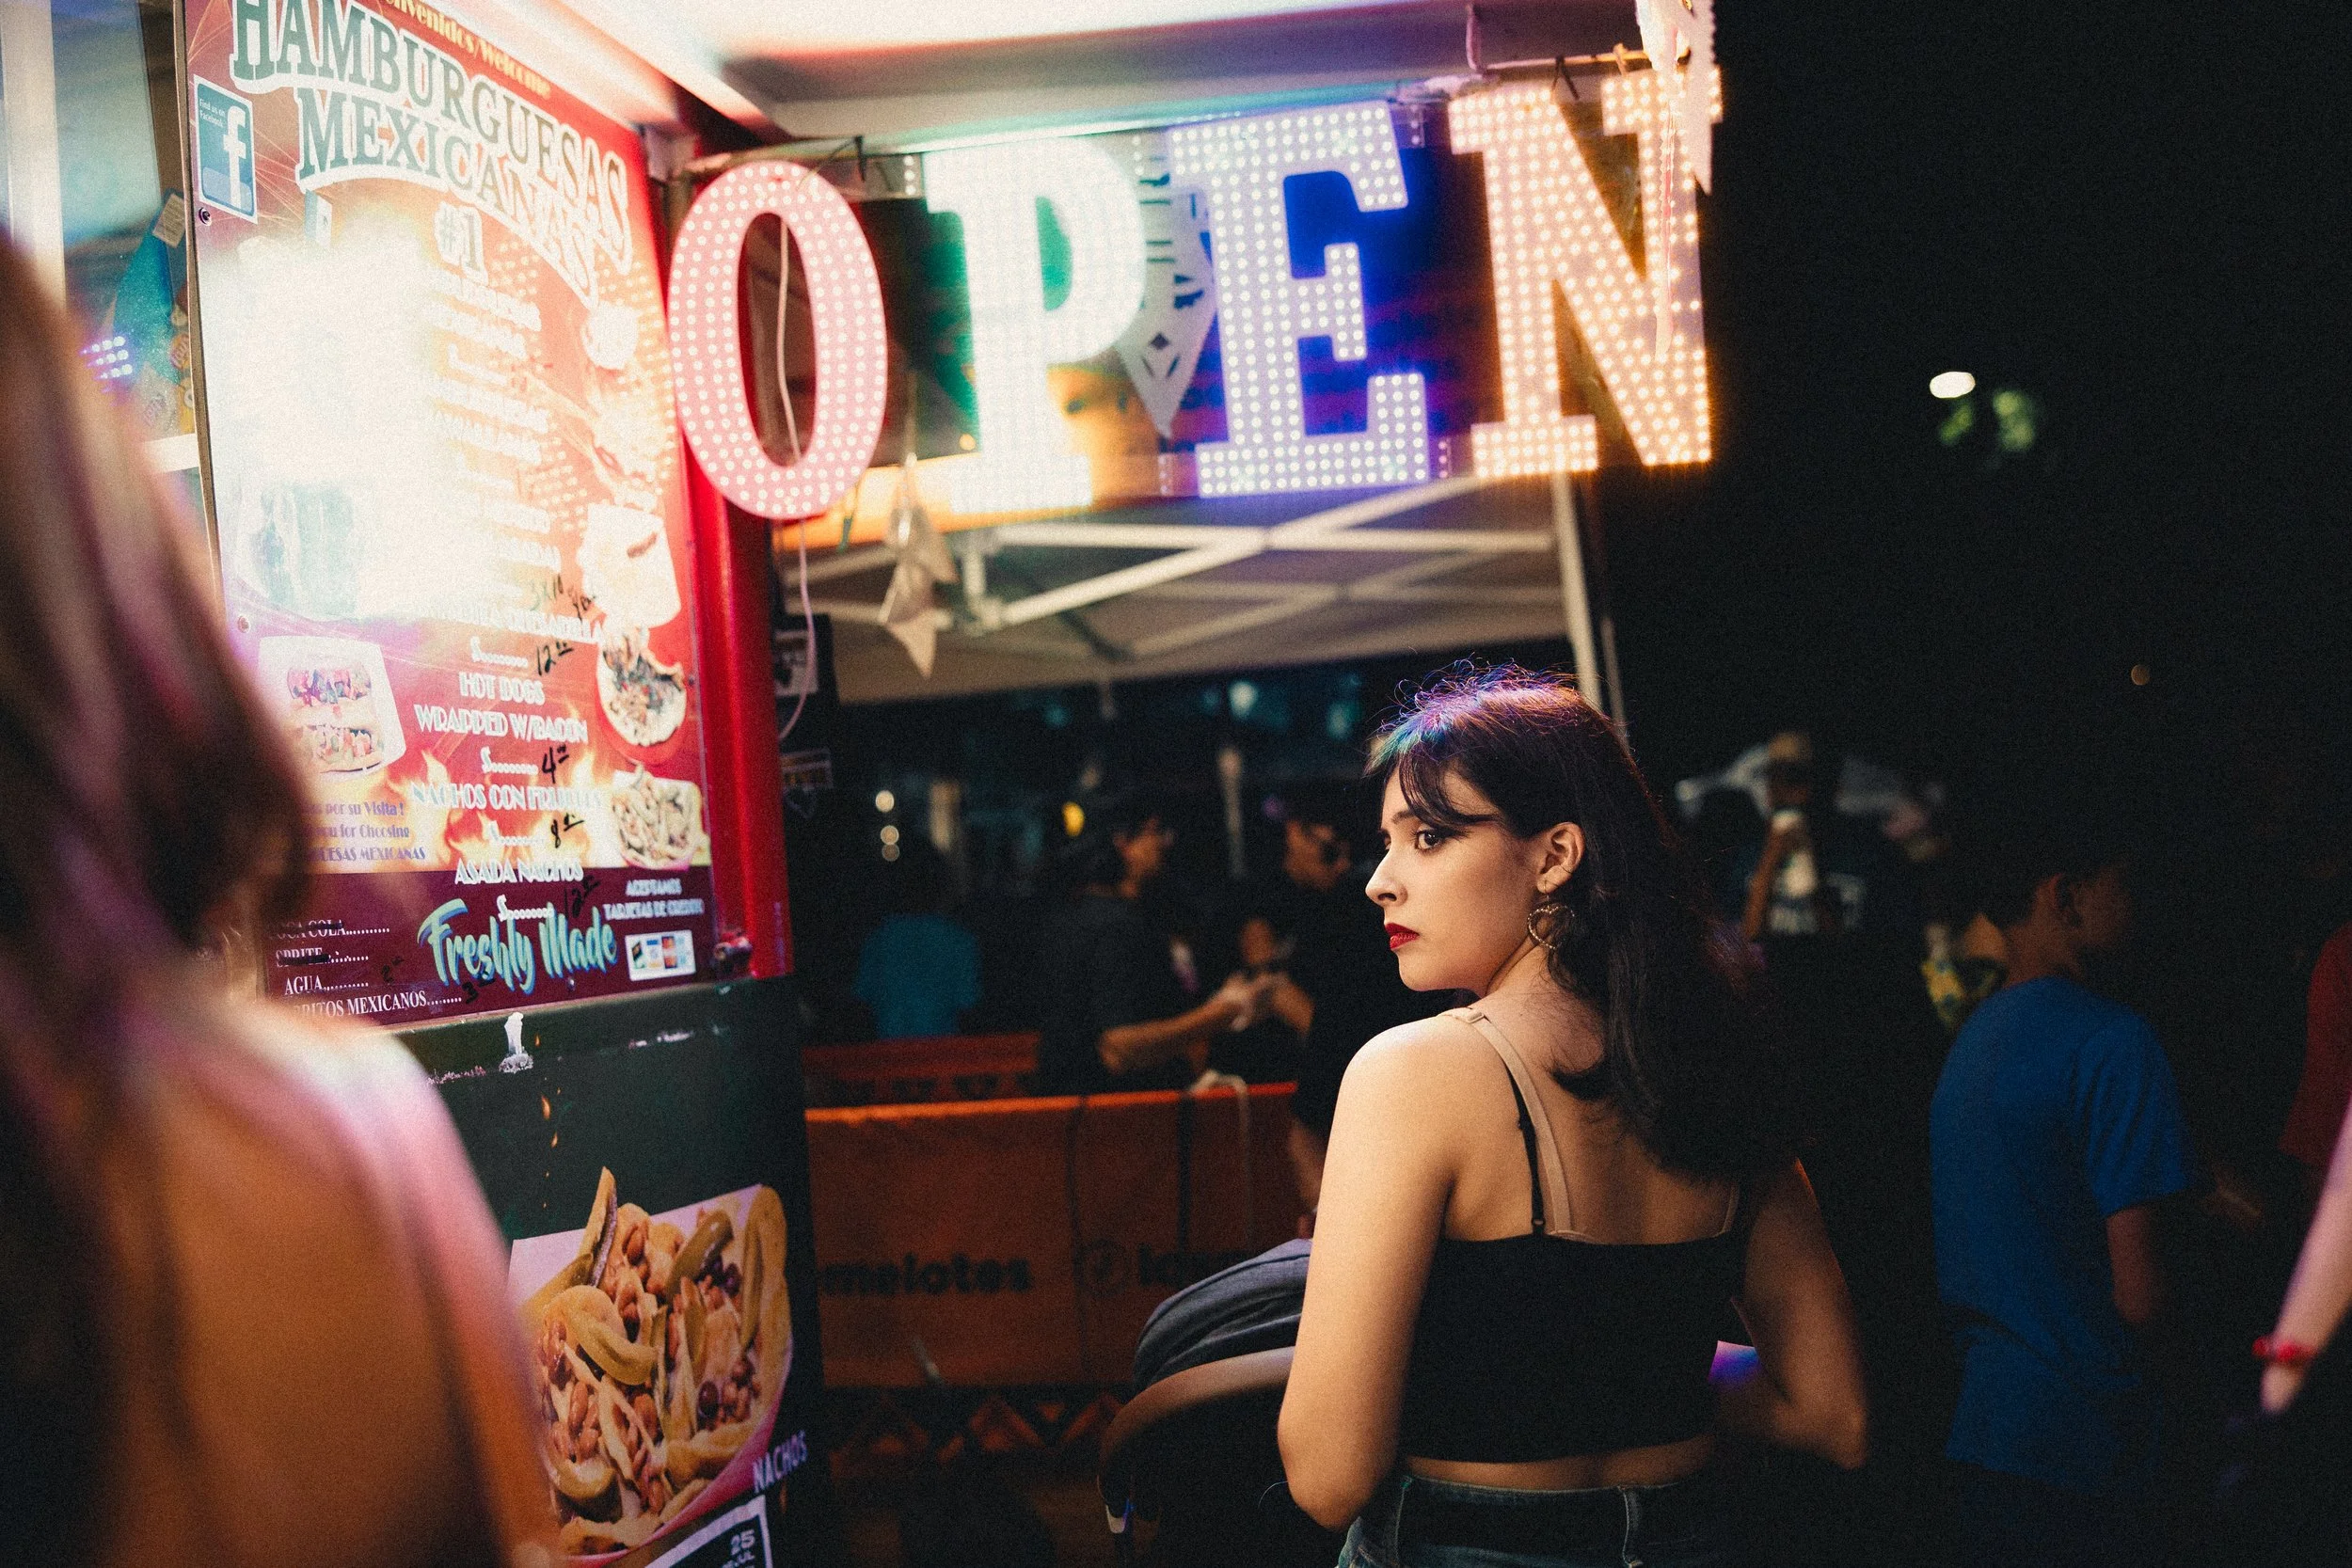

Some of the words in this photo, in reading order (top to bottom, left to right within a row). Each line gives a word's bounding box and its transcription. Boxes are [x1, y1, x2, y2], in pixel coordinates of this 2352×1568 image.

[231, 0, 632, 273] HAMBURGUESAS
[667, 66, 1723, 520] OPEN
[458, 671, 497, 700] HOT
[499, 674, 546, 705] DOGS
[414, 705, 508, 737] WRAPPED
[410, 782, 486, 810] NACHOS
[488, 783, 526, 810] CON
[455, 857, 516, 884] ASADA
[417, 897, 536, 995] Freshly
[538, 900, 618, 979] Made
[753, 1429, 809, 1494] NACHOS
